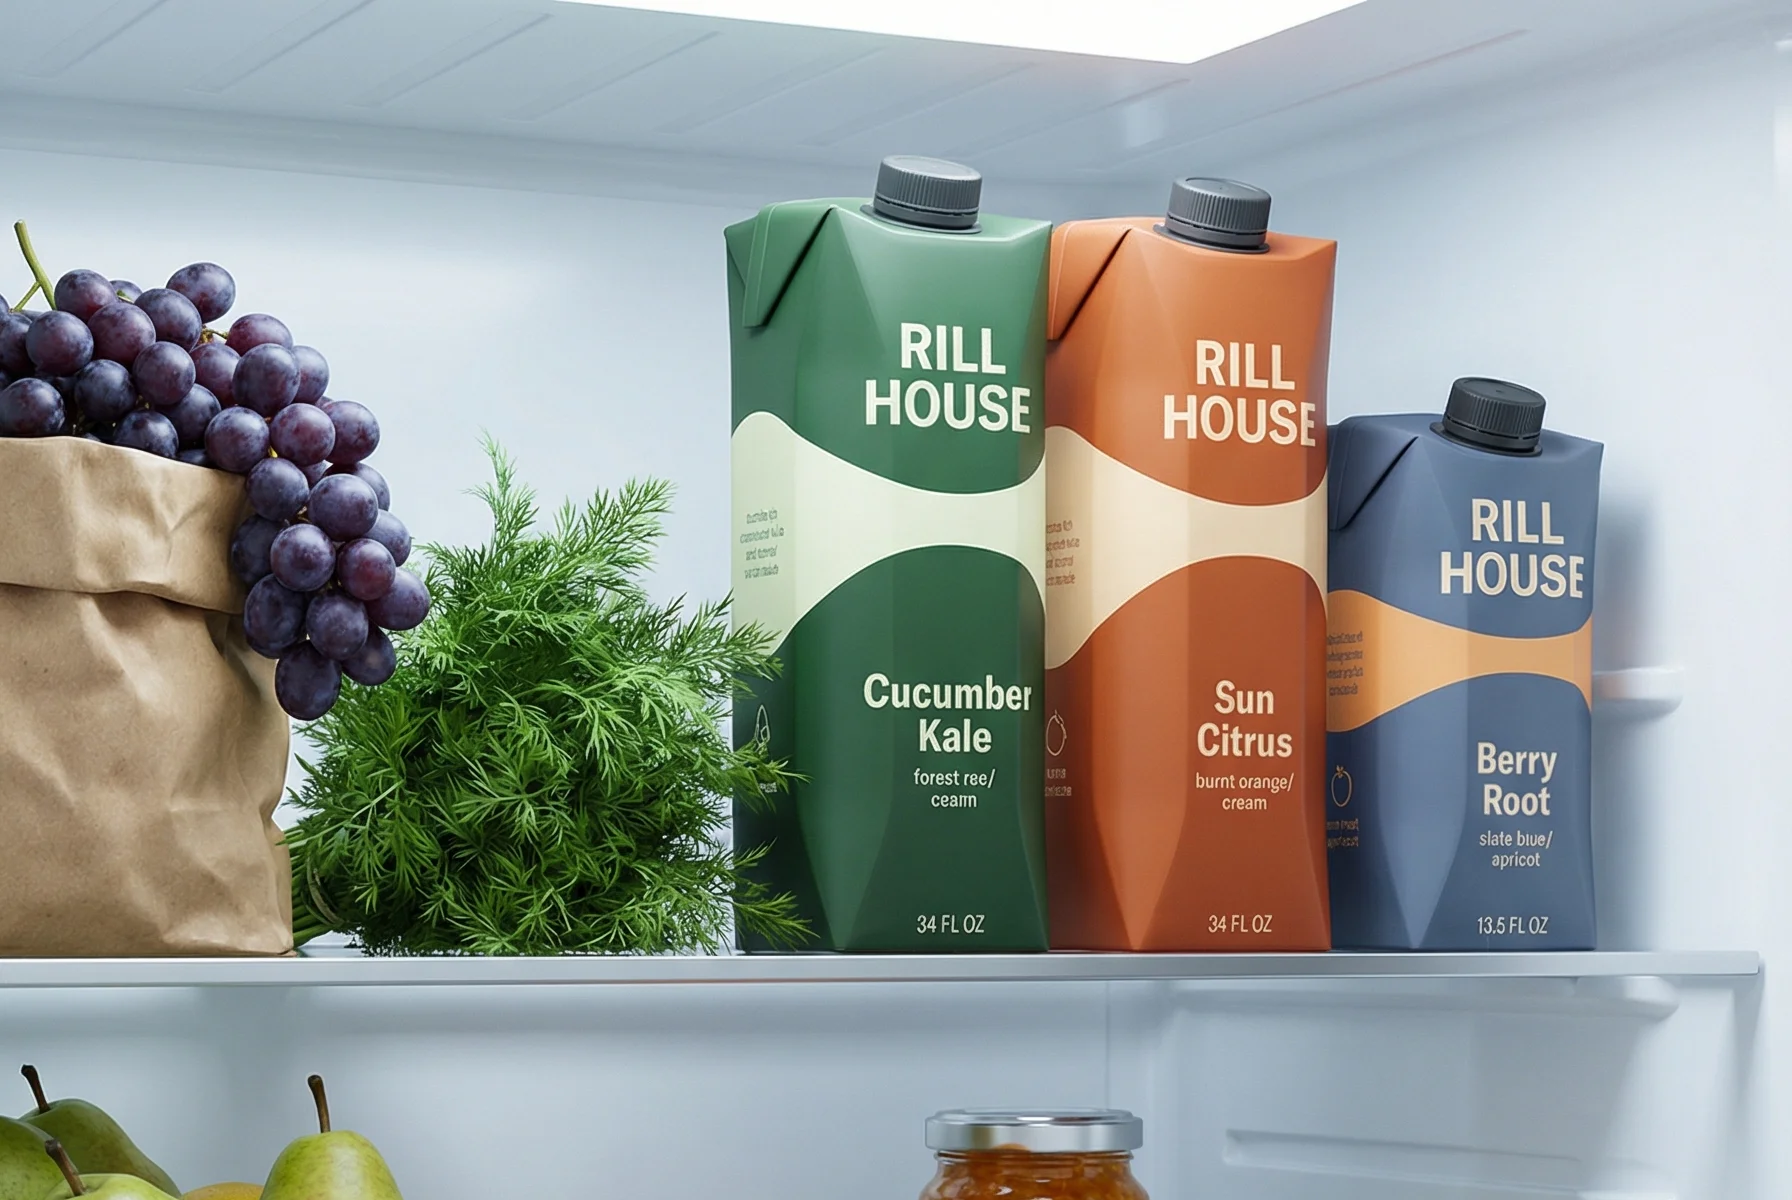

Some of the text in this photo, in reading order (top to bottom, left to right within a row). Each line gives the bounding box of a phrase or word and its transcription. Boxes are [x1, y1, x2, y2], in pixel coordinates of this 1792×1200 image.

[901, 322, 1006, 374] RILL
[1196, 339, 1296, 390] RILL
[865, 379, 1031, 434] HOUSE
[1163, 394, 1316, 447] HOUSE
[1471, 498, 1565, 545] RILL
[1440, 551, 1585, 599] HOUSE
[863, 673, 1032, 711] Cucumber
[1214, 679, 1274, 715] Sun
[919, 718, 992, 753] Kale
[1197, 722, 1293, 758] Citrus
[913, 767, 960, 786] forest
[1477, 741, 1557, 784] Berry
[1195, 771, 1295, 794] burnt orange/
[1483, 783, 1551, 816] Root
[1222, 797, 1267, 810] cream
[1479, 830, 1553, 849] slate blue/
[1491, 851, 1541, 871] apricot
[916, 914, 985, 934] 34 FL OZ
[1208, 914, 1273, 933] 34 FL OZ
[1477, 916, 1549, 935] 13.5 FL OZ
